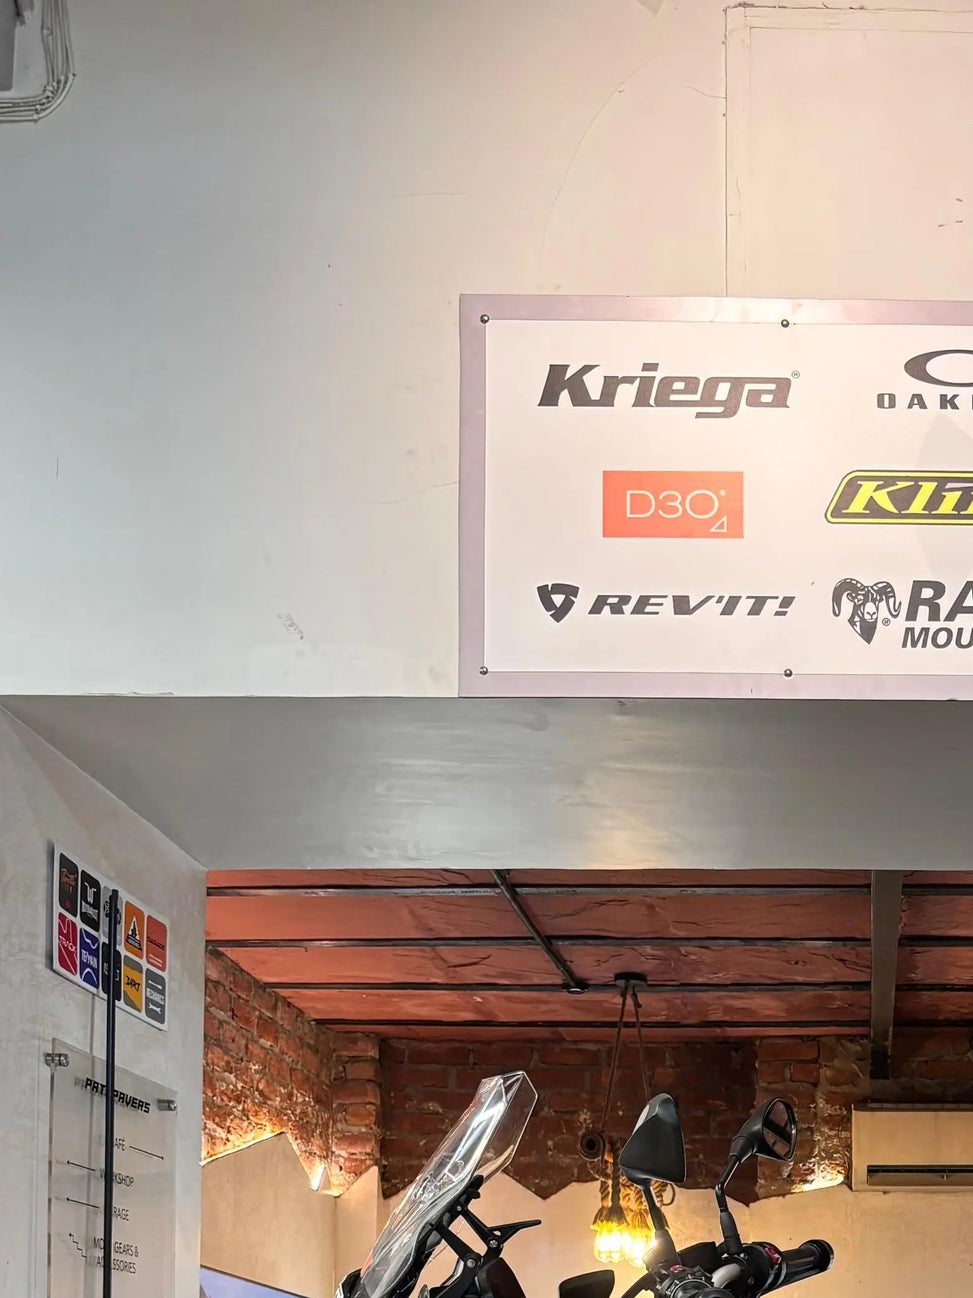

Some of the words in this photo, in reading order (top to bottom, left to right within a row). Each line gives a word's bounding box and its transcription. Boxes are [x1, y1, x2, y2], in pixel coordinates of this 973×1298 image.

[538, 363, 792, 419] Kriega
[587, 594, 796, 617] REV'IT!
[84, 1077, 151, 1114] PATPAVERS
